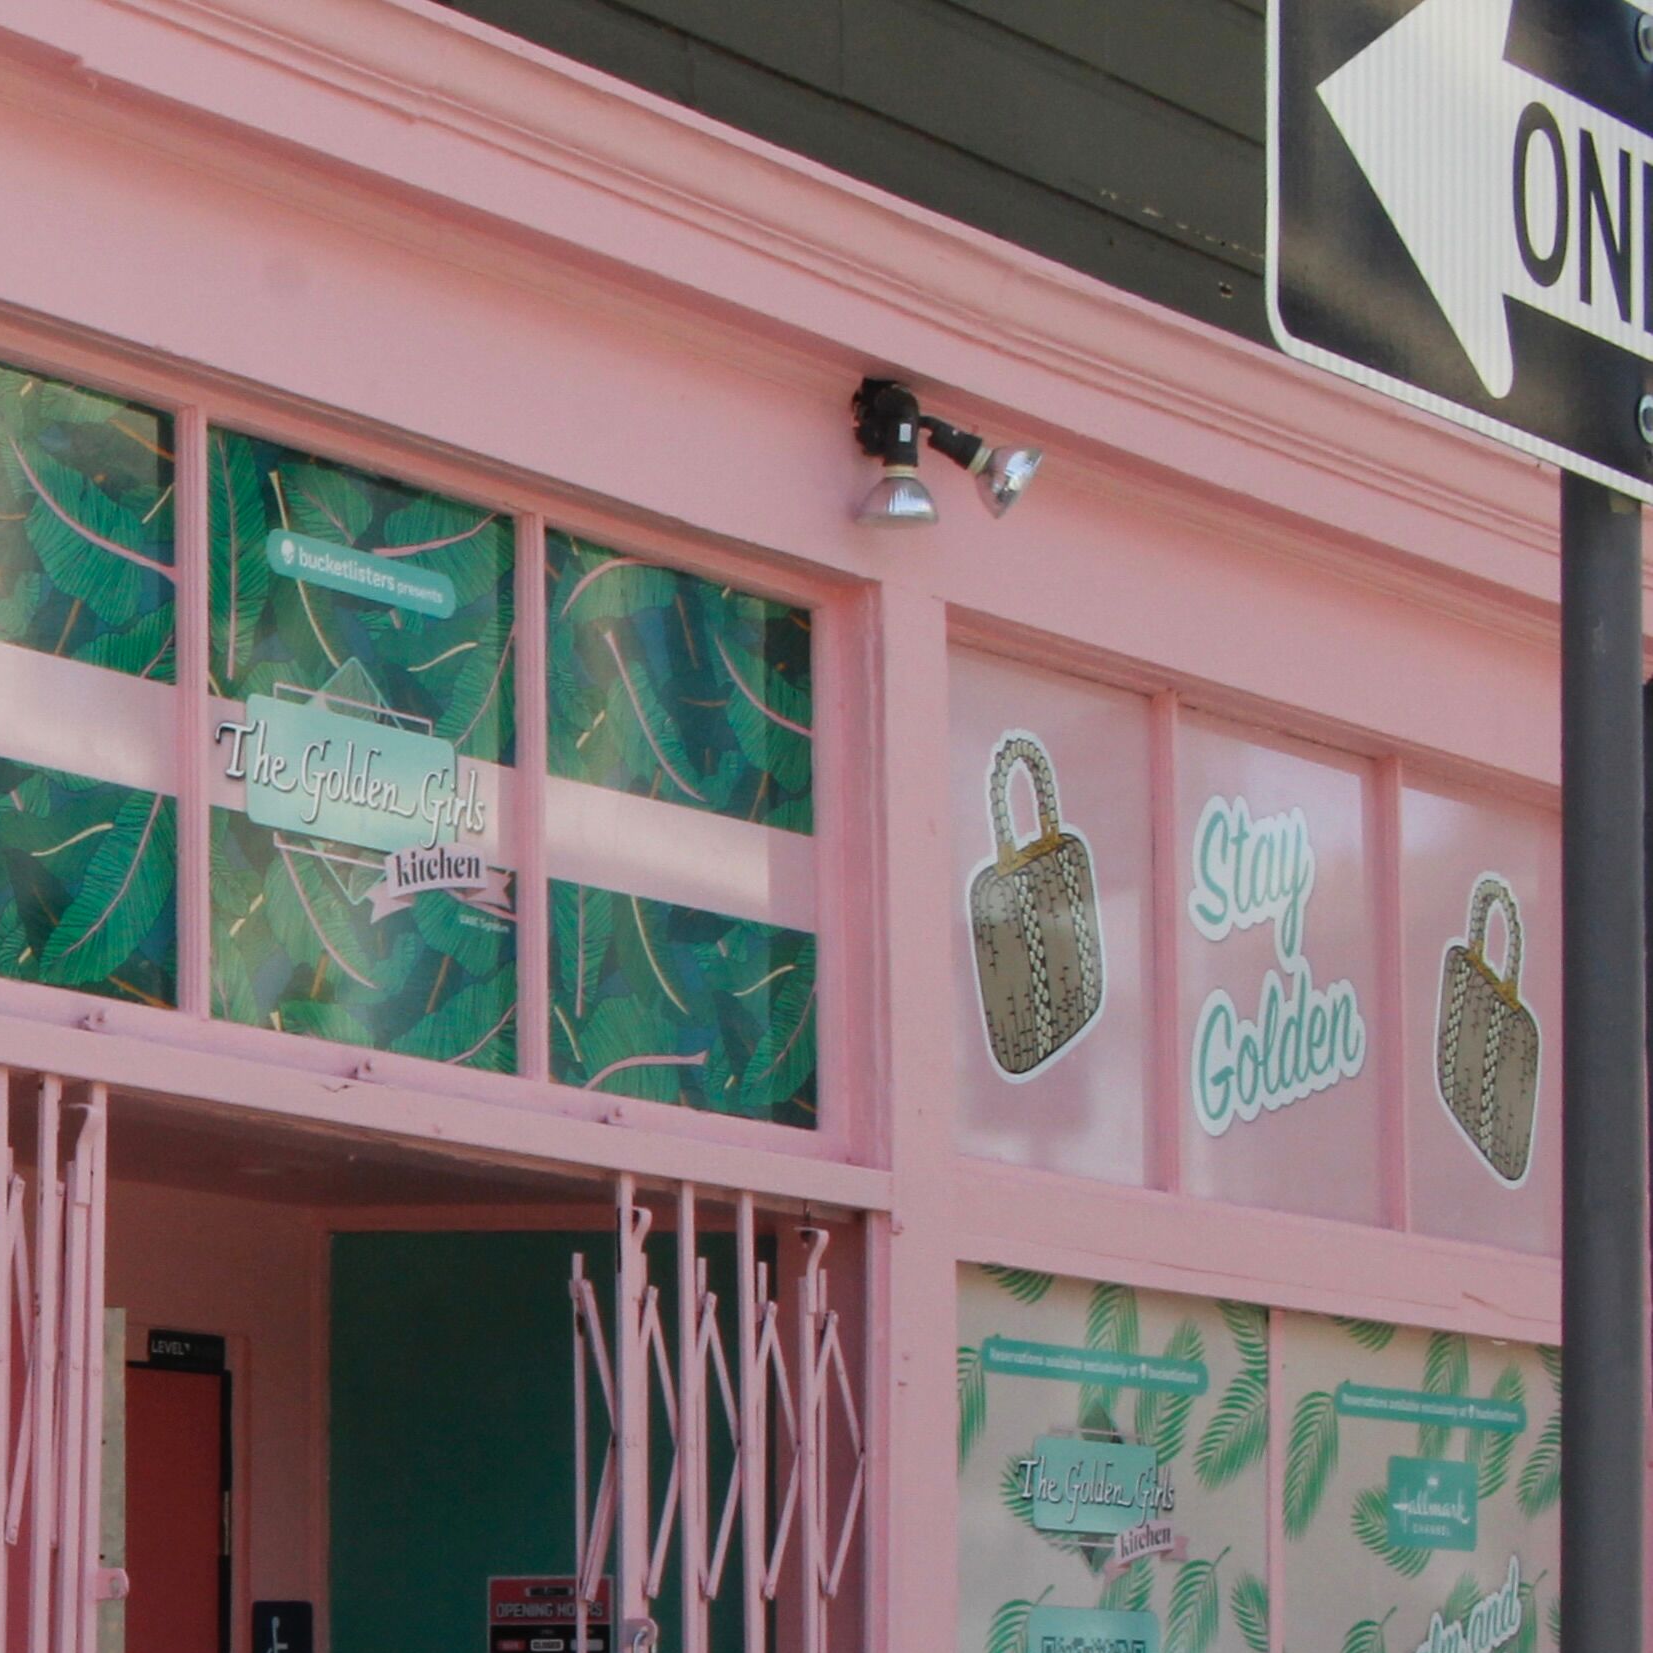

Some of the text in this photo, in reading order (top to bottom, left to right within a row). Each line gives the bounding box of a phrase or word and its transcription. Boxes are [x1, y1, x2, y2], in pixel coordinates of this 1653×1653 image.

[1513, 101, 1653, 336] ON
[298, 546, 394, 591] bucketlisters
[215, 718, 486, 849] The Golden Girls
[394, 846, 483, 888] kitchen
[1195, 809, 1310, 959] Stay
[1198, 971, 1362, 1121] Golden
[1019, 1456, 1174, 1528] The Golden Girls
[1120, 1524, 1171, 1558] kitchen
